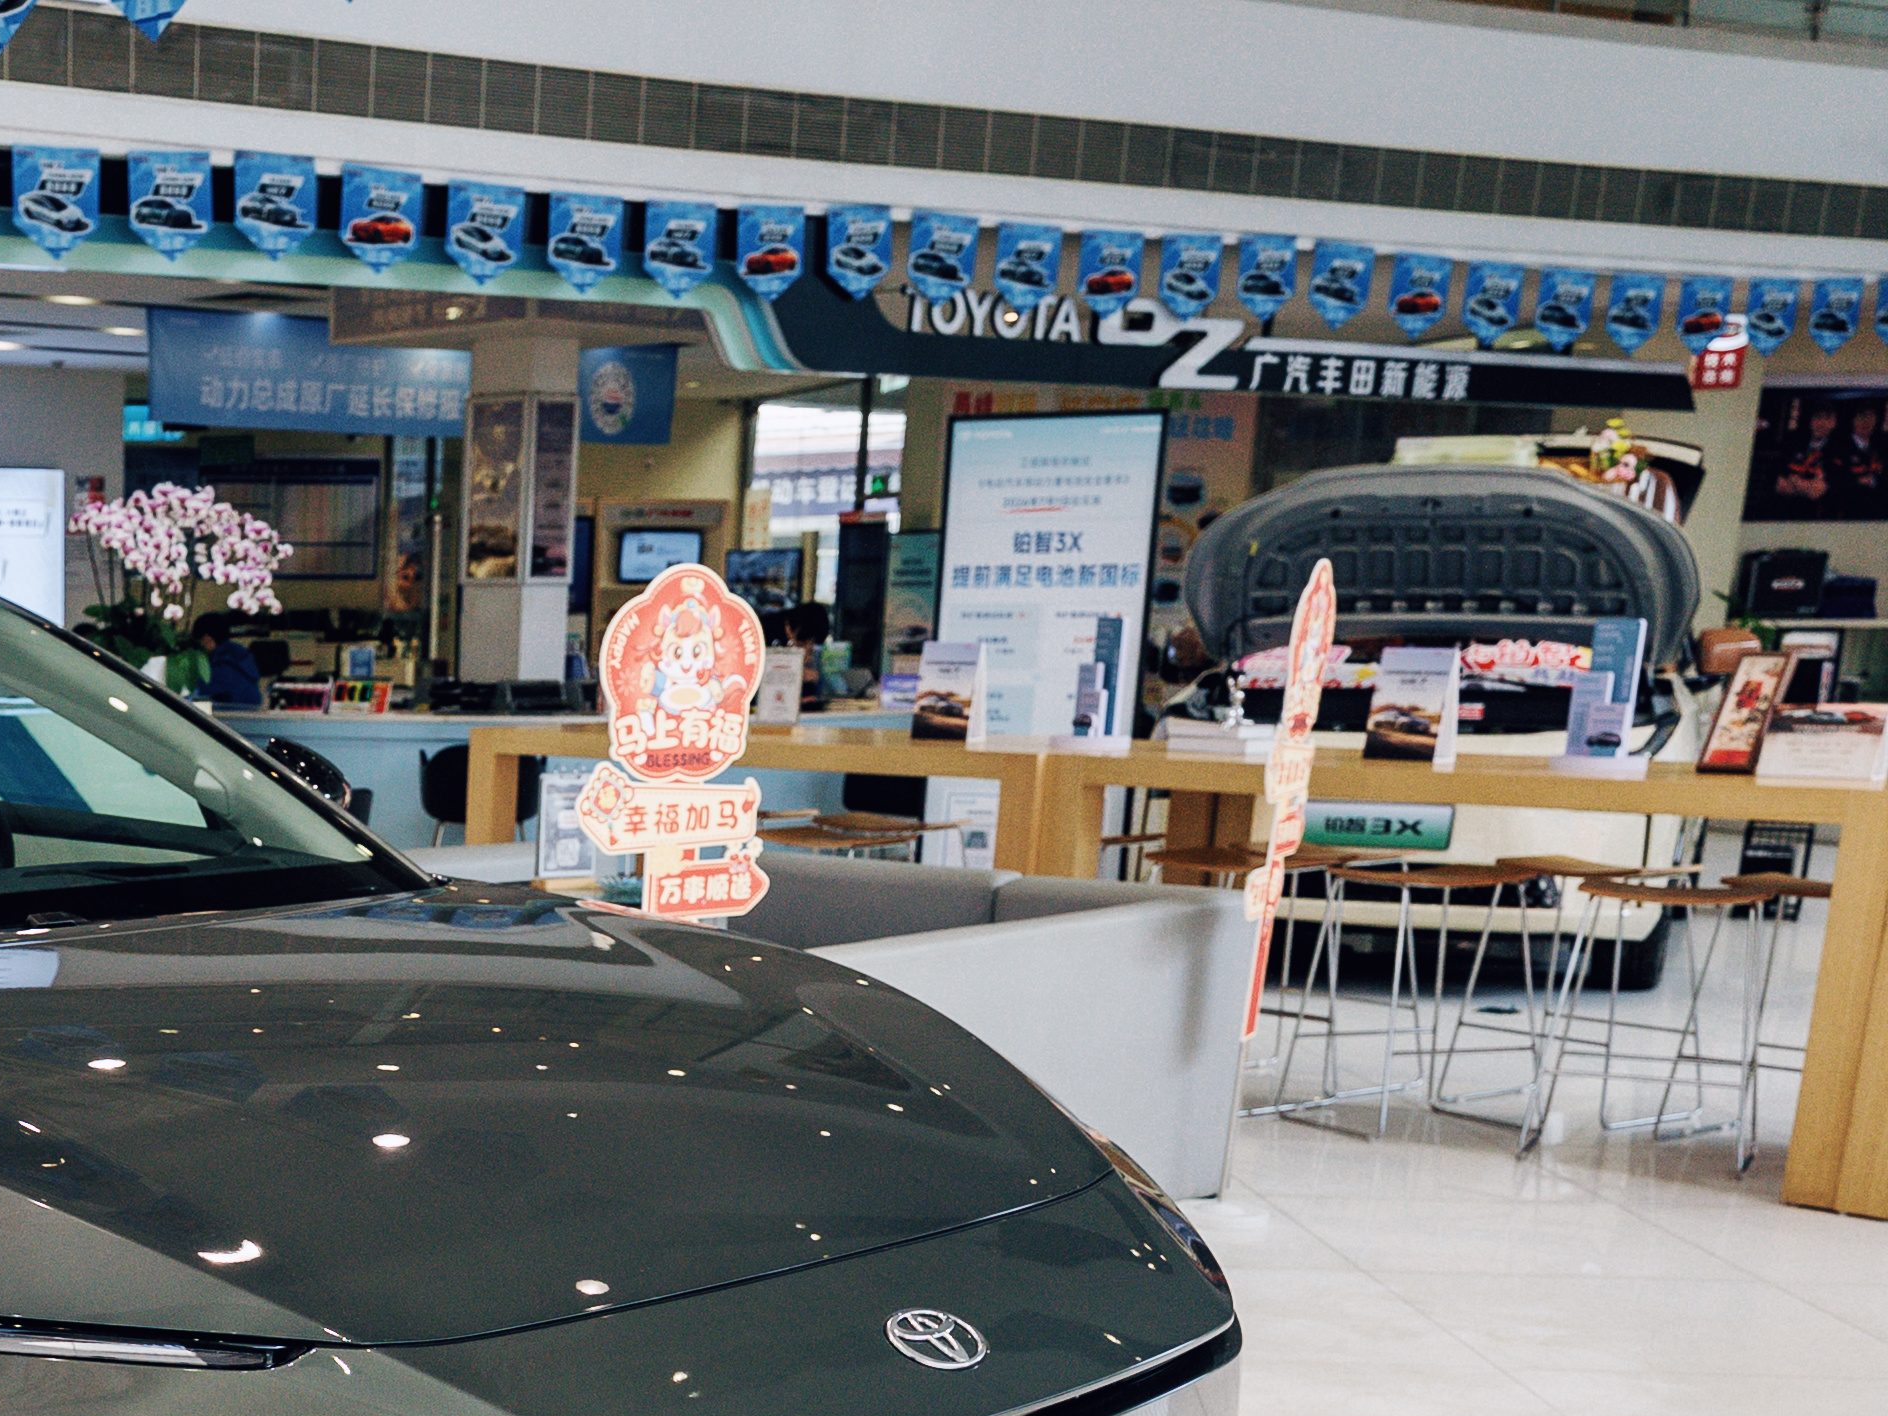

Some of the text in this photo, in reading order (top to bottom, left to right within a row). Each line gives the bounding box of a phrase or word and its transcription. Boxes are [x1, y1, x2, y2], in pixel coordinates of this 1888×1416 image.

[909, 290, 1082, 342] TOYOTA
[1250, 353, 1471, 400] 广汽丰田新能源
[952, 563, 1141, 589] 提前满足电池新国标
[738, 618, 758, 666] TIME
[615, 706, 745, 756] 马上有福
[646, 752, 711, 768] BLESSING
[623, 799, 739, 837] 幸福加马
